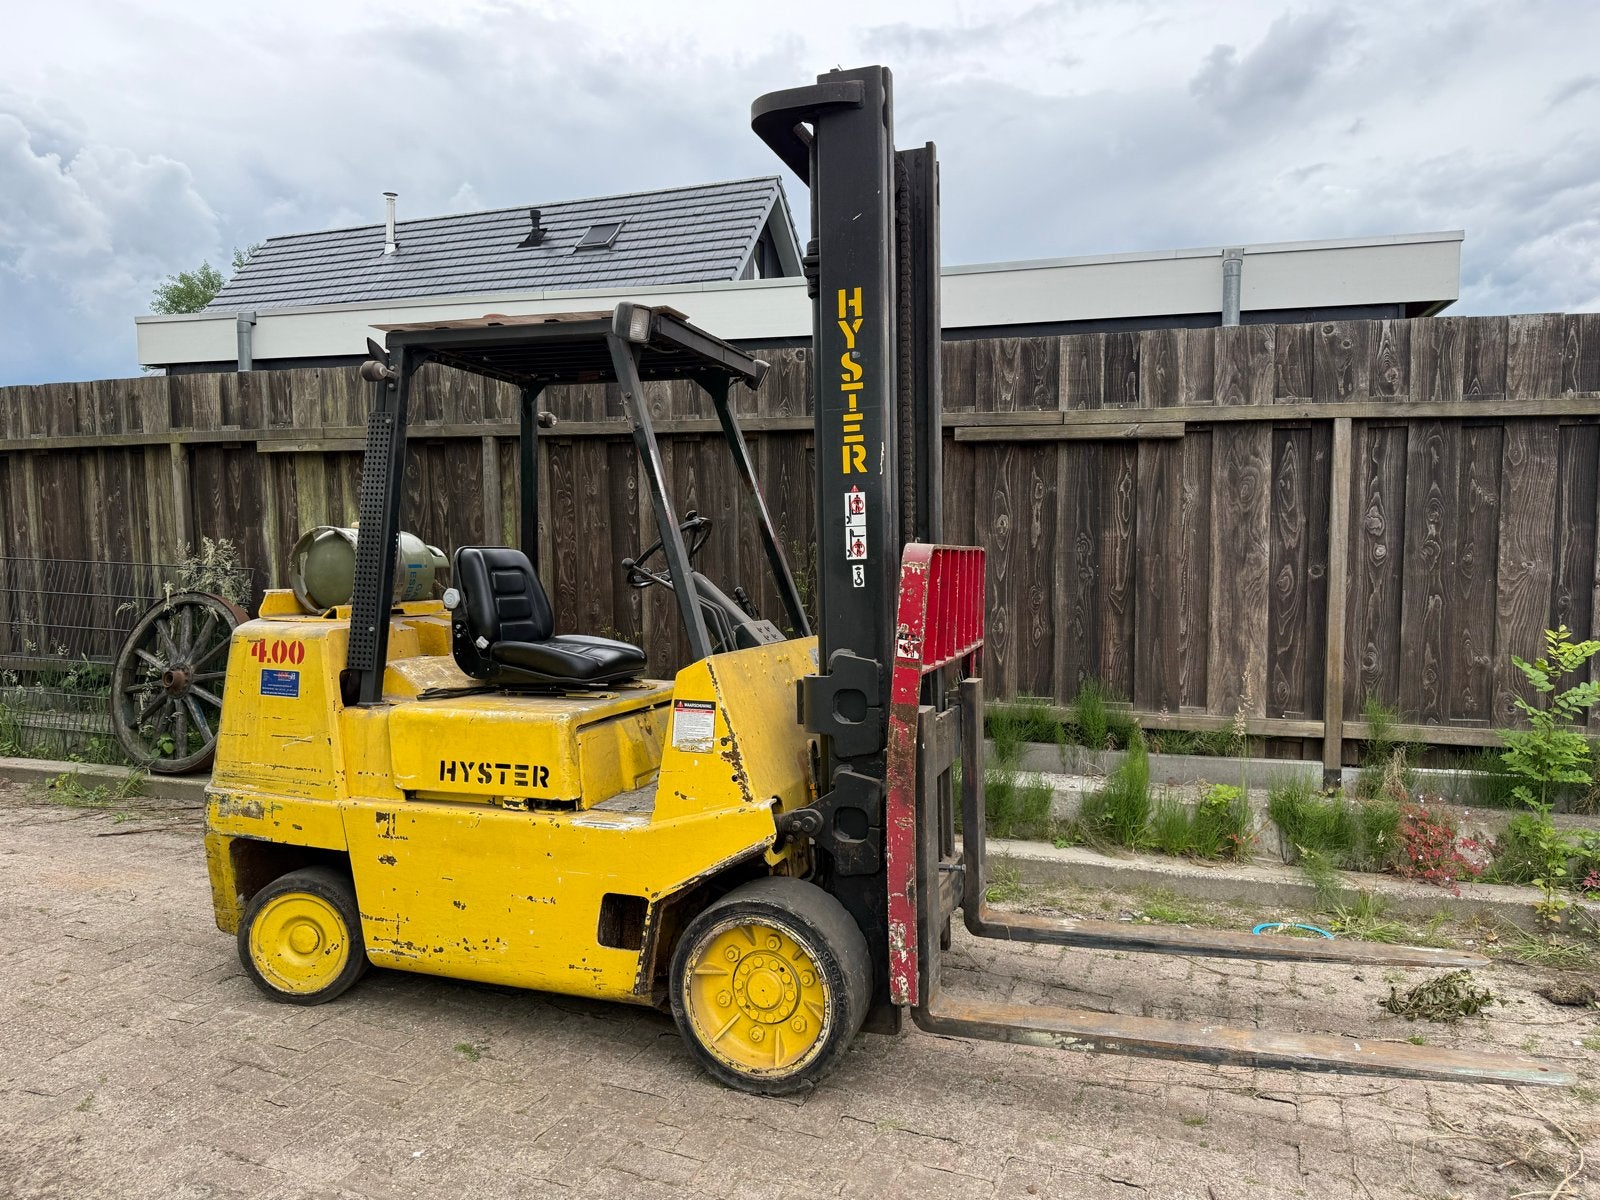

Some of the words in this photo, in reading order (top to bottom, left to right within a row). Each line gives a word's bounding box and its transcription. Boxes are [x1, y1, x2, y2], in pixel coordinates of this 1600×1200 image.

[837, 286, 868, 475] HYSTER
[251, 638, 305, 665] 4.00
[440, 760, 550, 788] HYSTER
